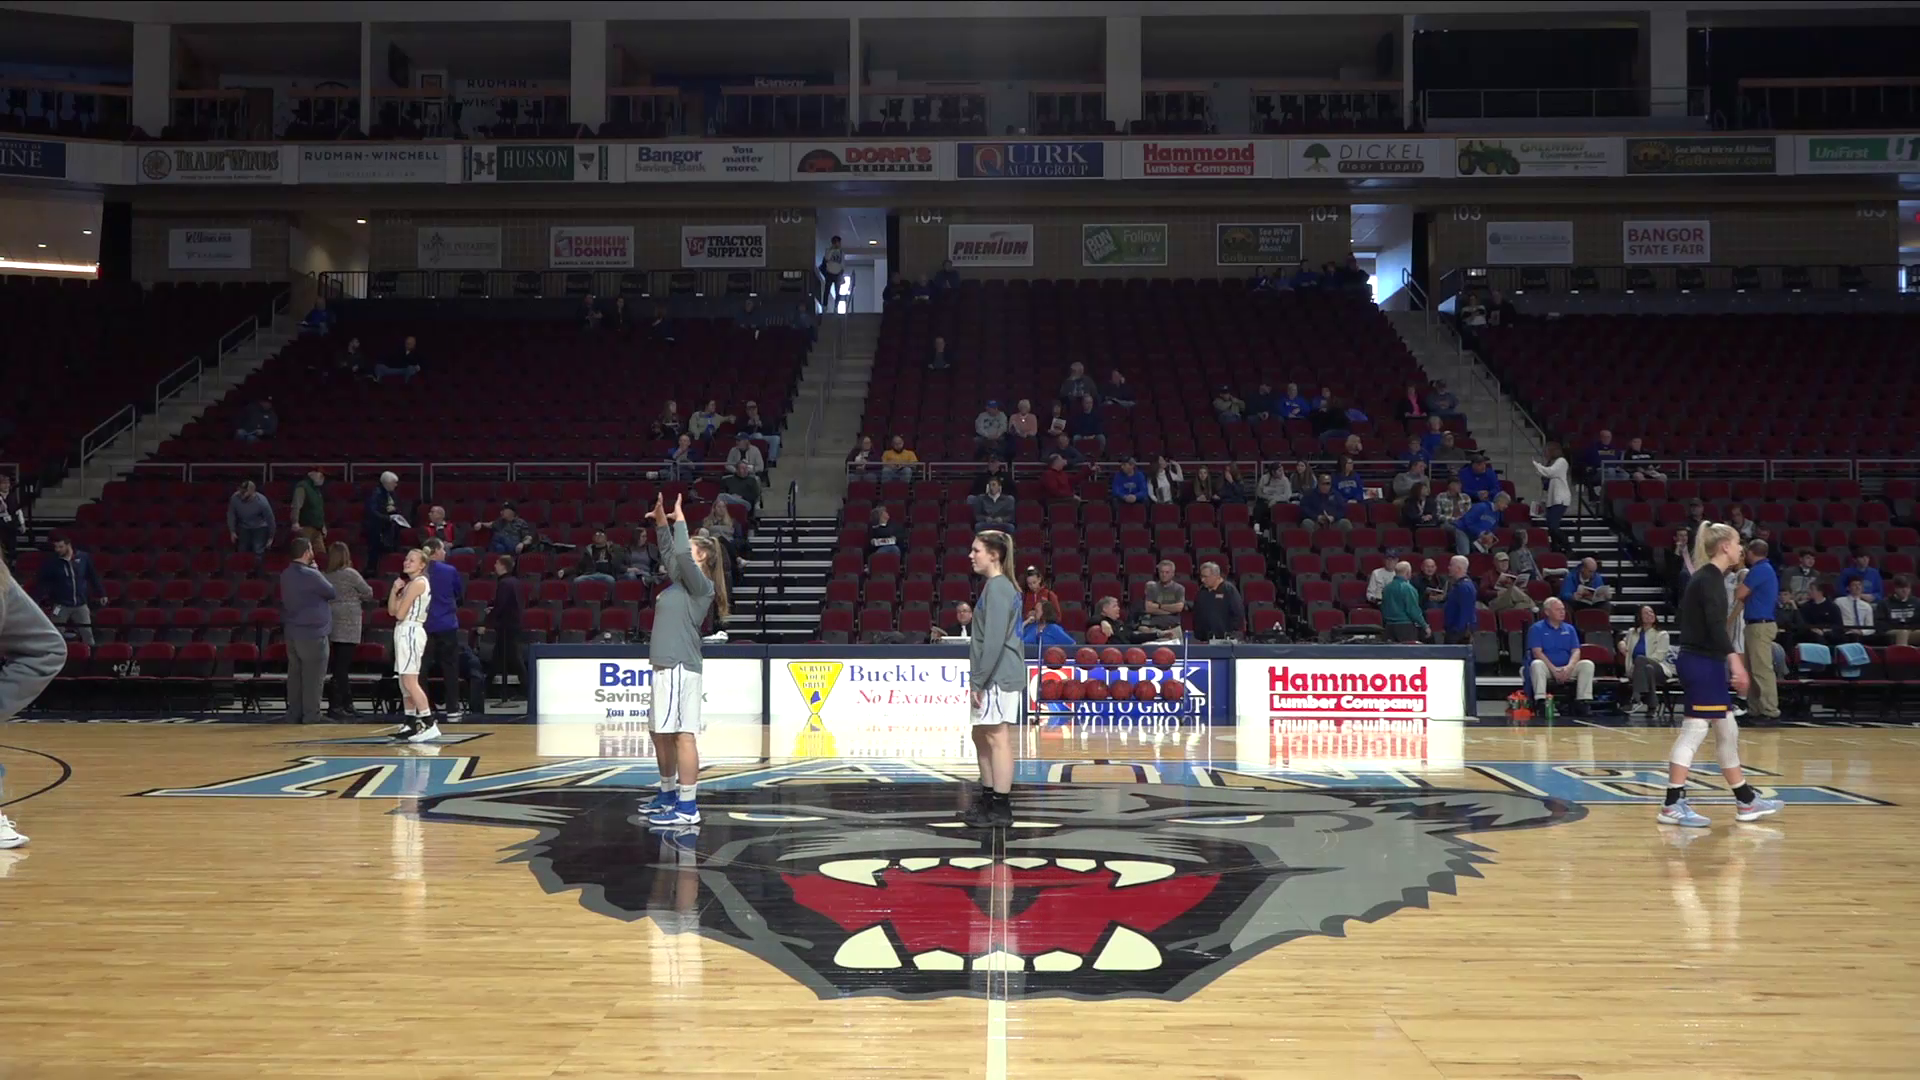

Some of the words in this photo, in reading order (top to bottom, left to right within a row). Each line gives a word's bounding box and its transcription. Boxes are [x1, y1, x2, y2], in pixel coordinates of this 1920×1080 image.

[467, 79, 527, 88] RUDMAN
[304, 152, 352, 160] RUDMAN
[371, 152, 440, 160] WINCHELL
[638, 147, 703, 164] Bangor
[732, 146, 753, 154] You
[1144, 143, 1255, 160] Hammond
[1340, 144, 1425, 159] DICKEL
[1816, 146, 1869, 159] UniFirst
[503, 150, 568, 168] HUSSON
[635, 163, 674, 173] Savings
[678, 163, 706, 172] Bank
[1007, 164, 1041, 176] AUTO
[1044, 164, 1089, 176] GROUP
[1146, 163, 1190, 173] Lumber
[1194, 163, 1251, 176] Company
[1340, 163, 1372, 171] Floor
[1380, 162, 1422, 172] Supply
[774, 208, 802, 224] 105
[915, 208, 943, 223] 104
[1309, 206, 1339, 221] 104
[1453, 205, 1481, 220] 103
[707, 236, 763, 246] TRACTOR
[1085, 228, 1113, 252] BDN
[1123, 230, 1162, 243] Follow
[1627, 227, 1705, 241] BANGOR
[575, 247, 628, 257] DONUTS
[707, 247, 748, 257] SUPPLY
[953, 237, 1029, 254] PREMIUM
[1628, 244, 1669, 256] STATE
[1673, 244, 1705, 255] FAIR
[599, 663, 653, 687] Ban
[849, 664, 930, 683] Buckle
[941, 665, 971, 688] Up
[1268, 666, 1428, 692] Hammond
[594, 688, 651, 706] Saving
[856, 688, 882, 705] No
[887, 688, 970, 705] Excuses!
[1272, 694, 1337, 709] Lumber
[1340, 695, 1424, 712] Company
